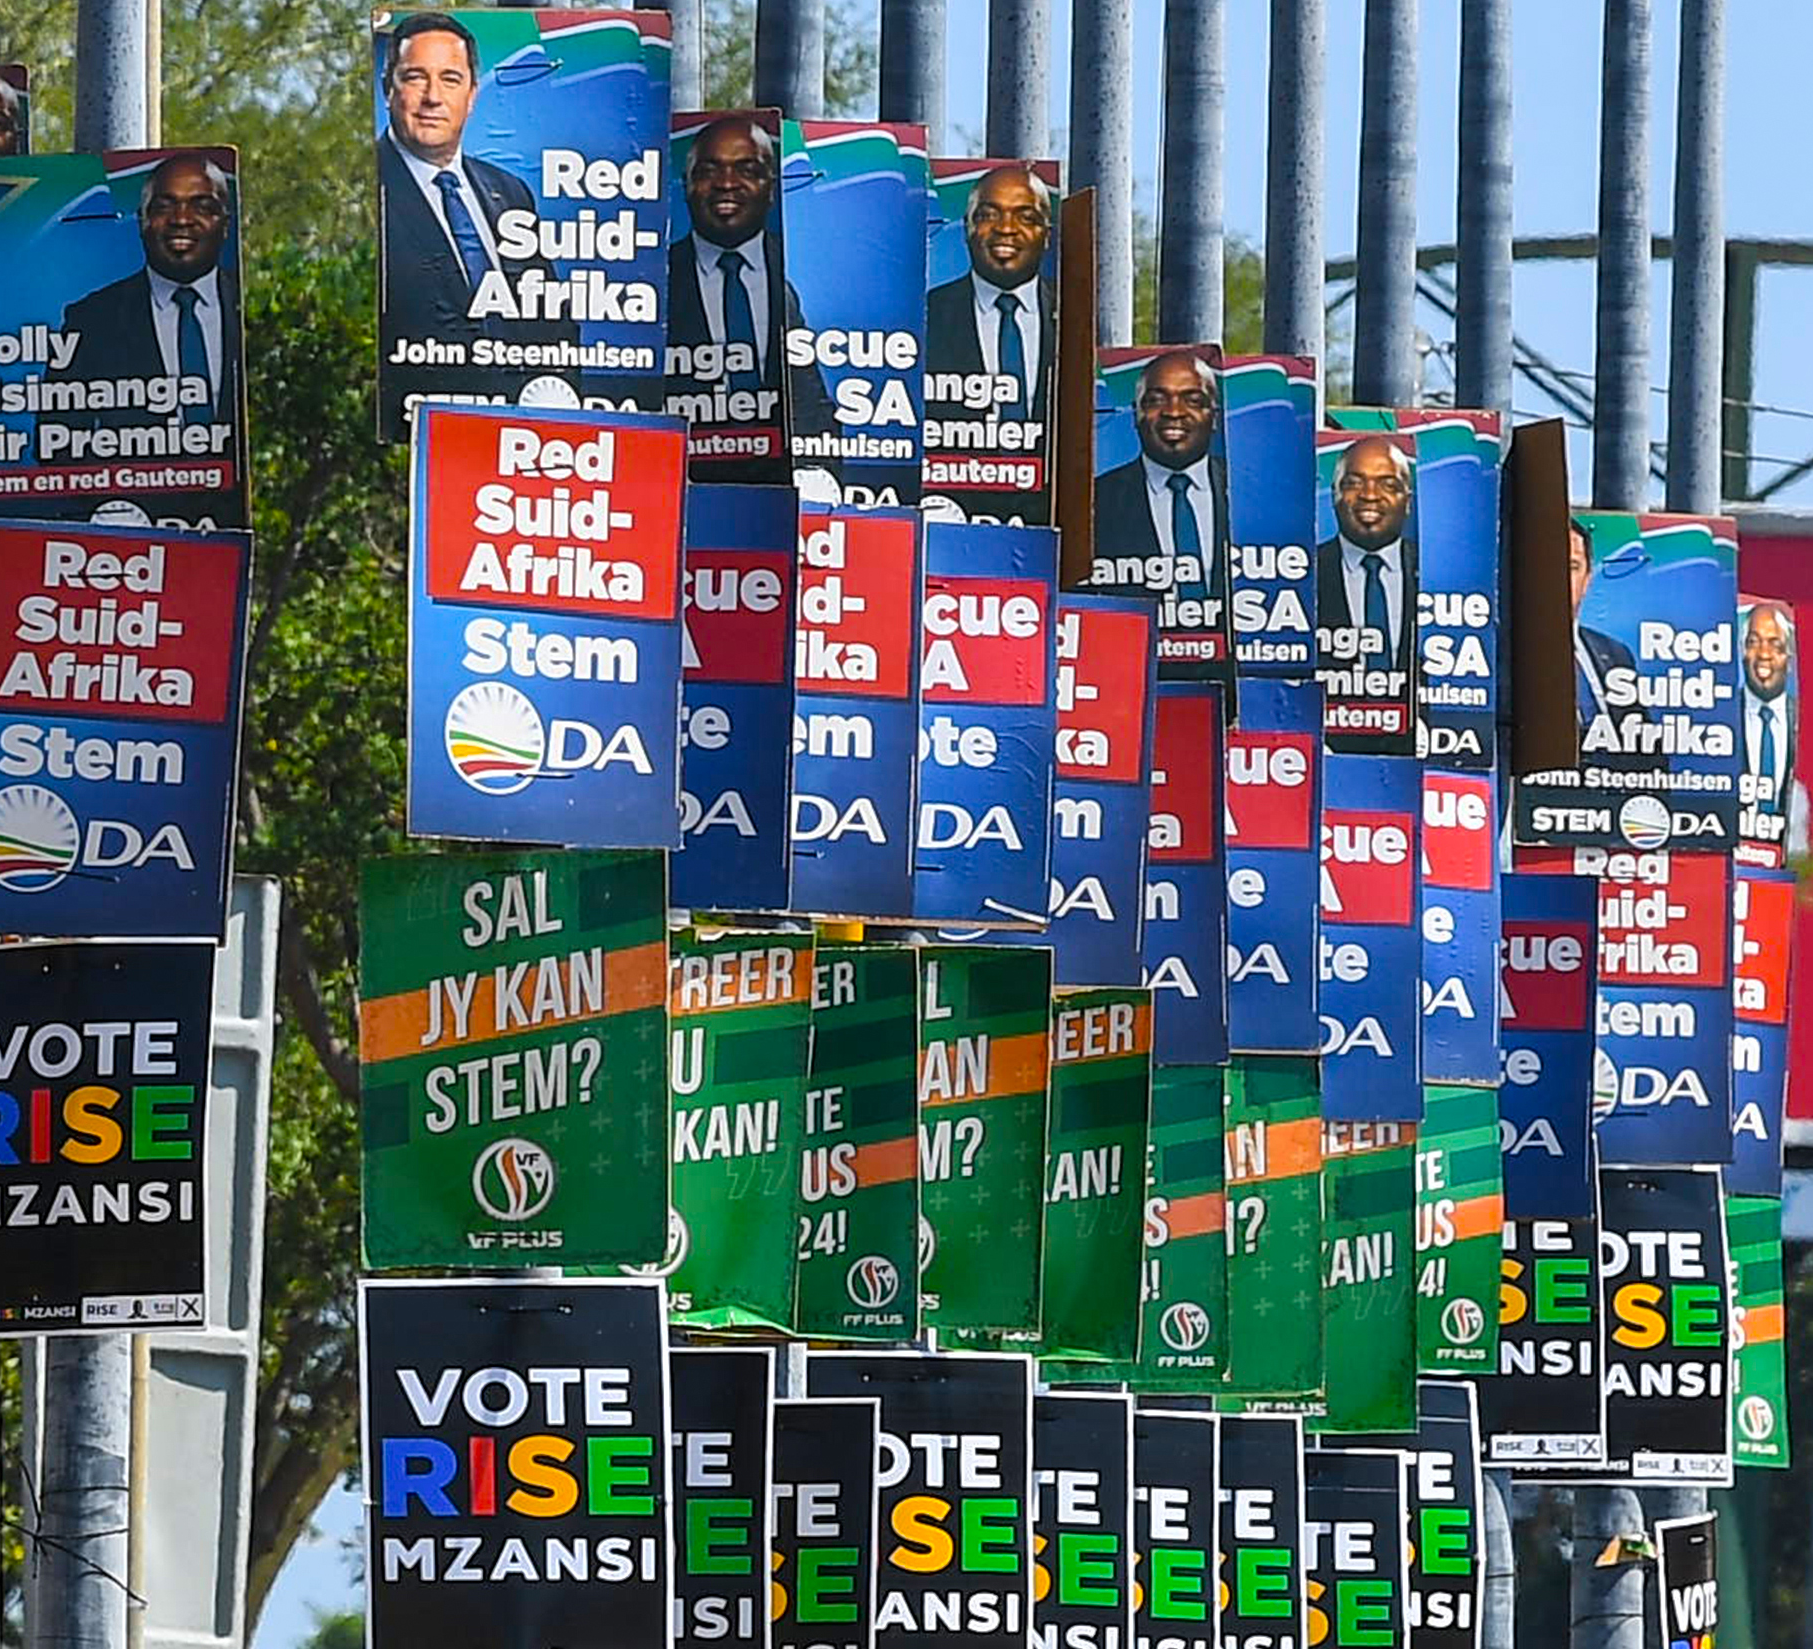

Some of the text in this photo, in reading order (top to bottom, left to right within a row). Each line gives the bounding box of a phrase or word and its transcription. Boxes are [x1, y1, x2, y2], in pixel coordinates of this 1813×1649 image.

[542, 150, 660, 199] Red
[495, 210, 660, 261] Suid-
[468, 271, 658, 322] Afrika
[389, 339, 654, 369] John Steenhuisen
[39, 420, 233, 460] Premier
[33, 474, 65, 491] en
[68, 470, 110, 490] red
[115, 466, 223, 491] Gauteng
[1638, 621, 1732, 661] Red
[1603, 668, 1733, 708] Suid-
[1582, 714, 1734, 756] Afrika
[1532, 808, 1724, 835] STEM DA
[462, 871, 563, 948] SAL
[420, 948, 604, 1048] JY KAN
[424, 1039, 603, 1134] STEM?
[503, 1229, 563, 1248] PLUS
[24, 1305, 75, 1320] MZANSI
[85, 1302, 118, 1318] RISE
[396, 1368, 633, 1426] VOTE
[382, 1435, 655, 1518] RISE
[383, 1538, 656, 1582] MZANSI
